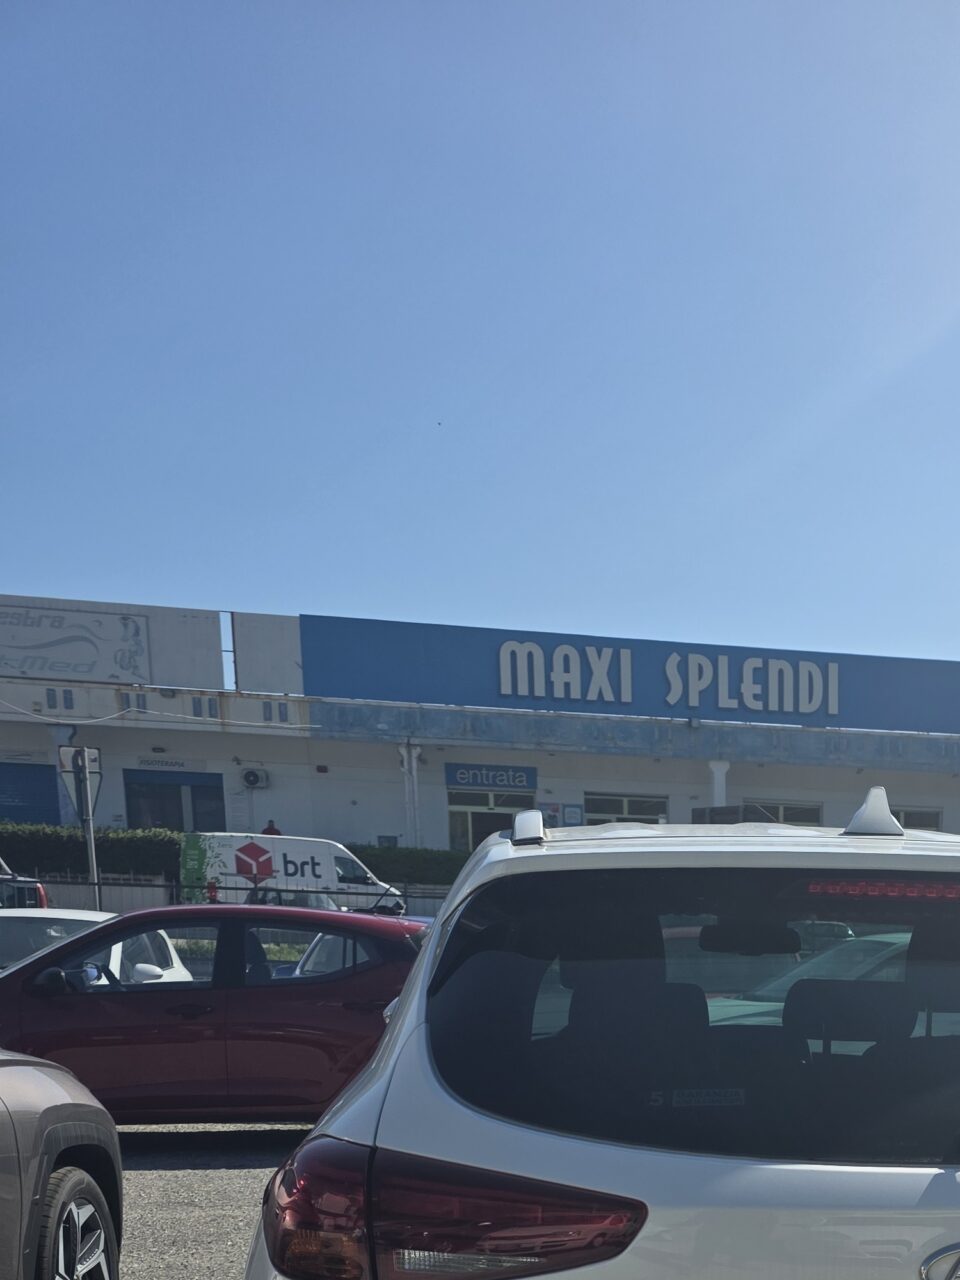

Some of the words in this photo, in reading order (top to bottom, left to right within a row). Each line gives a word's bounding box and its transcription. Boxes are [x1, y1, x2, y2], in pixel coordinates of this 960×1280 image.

[499, 640, 633, 703] MAXI
[665, 651, 839, 715] SPLENDI
[456, 766, 527, 787] entrata
[282, 852, 322, 879] brt
